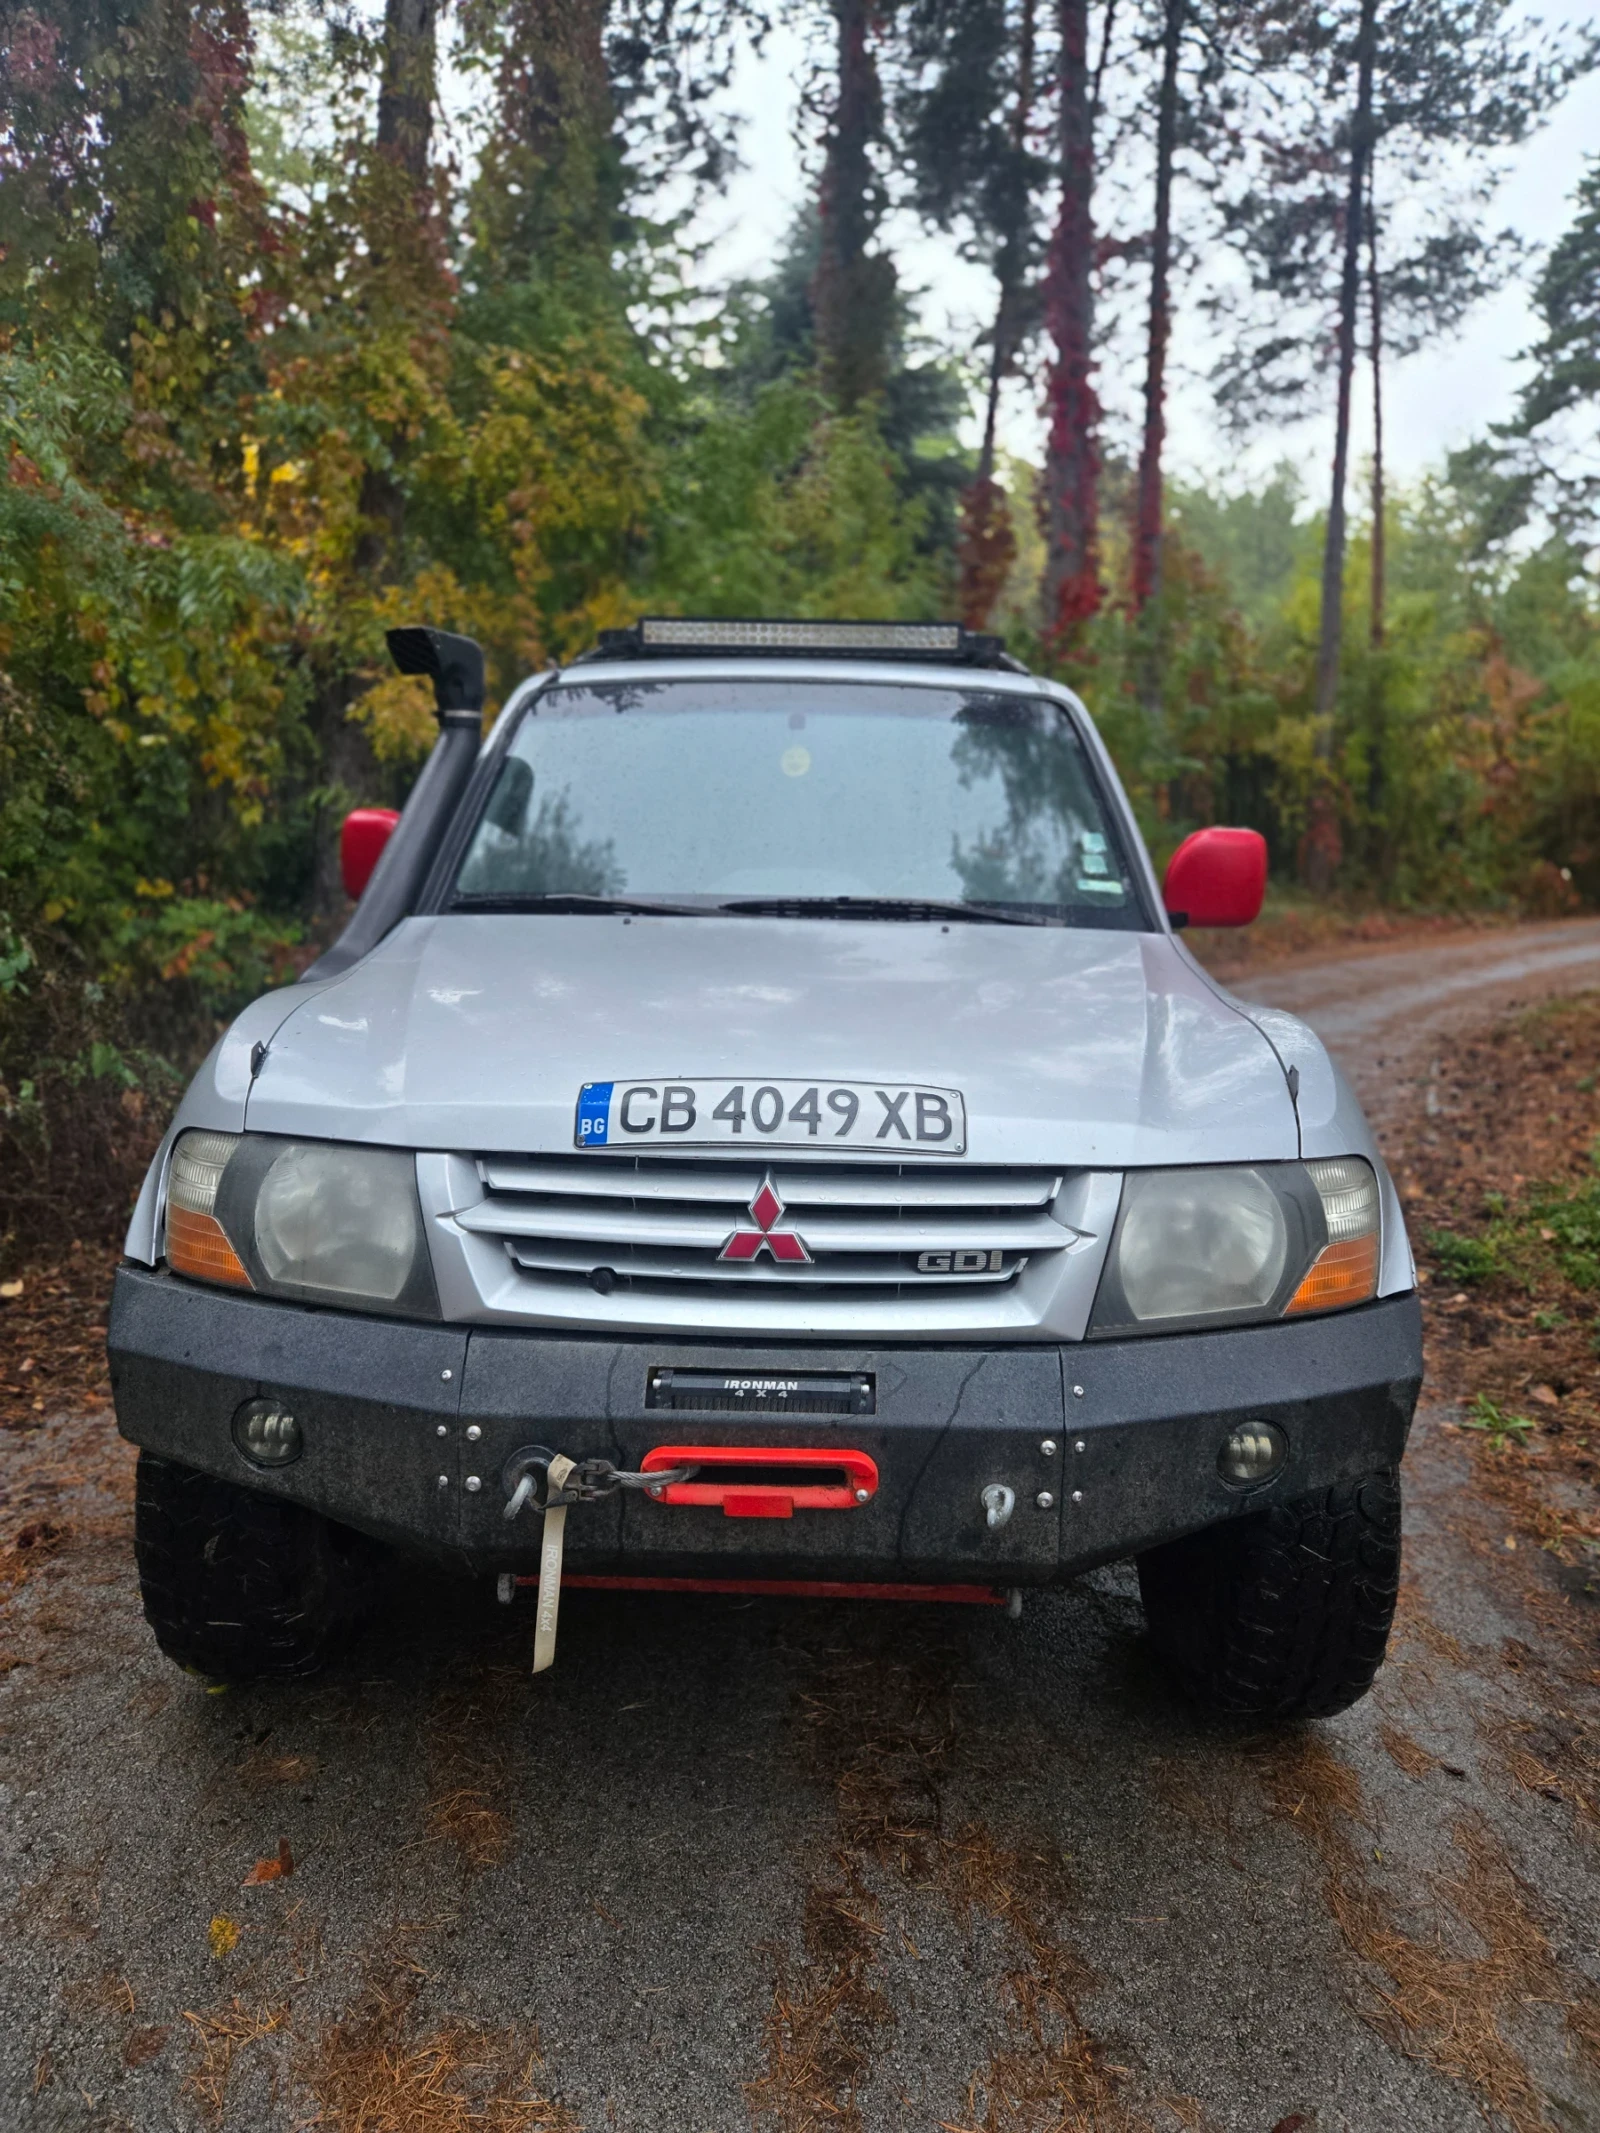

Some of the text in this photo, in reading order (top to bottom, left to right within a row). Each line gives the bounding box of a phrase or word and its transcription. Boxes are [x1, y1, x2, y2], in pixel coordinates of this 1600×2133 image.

[620, 1085, 953, 1142] CB 4049 XB
[580, 1117, 605, 1136] BG
[917, 1250, 1003, 1272] GDI
[724, 1380, 798, 1390] IRONMAN
[542, 1545, 558, 1607] IRONMAN
